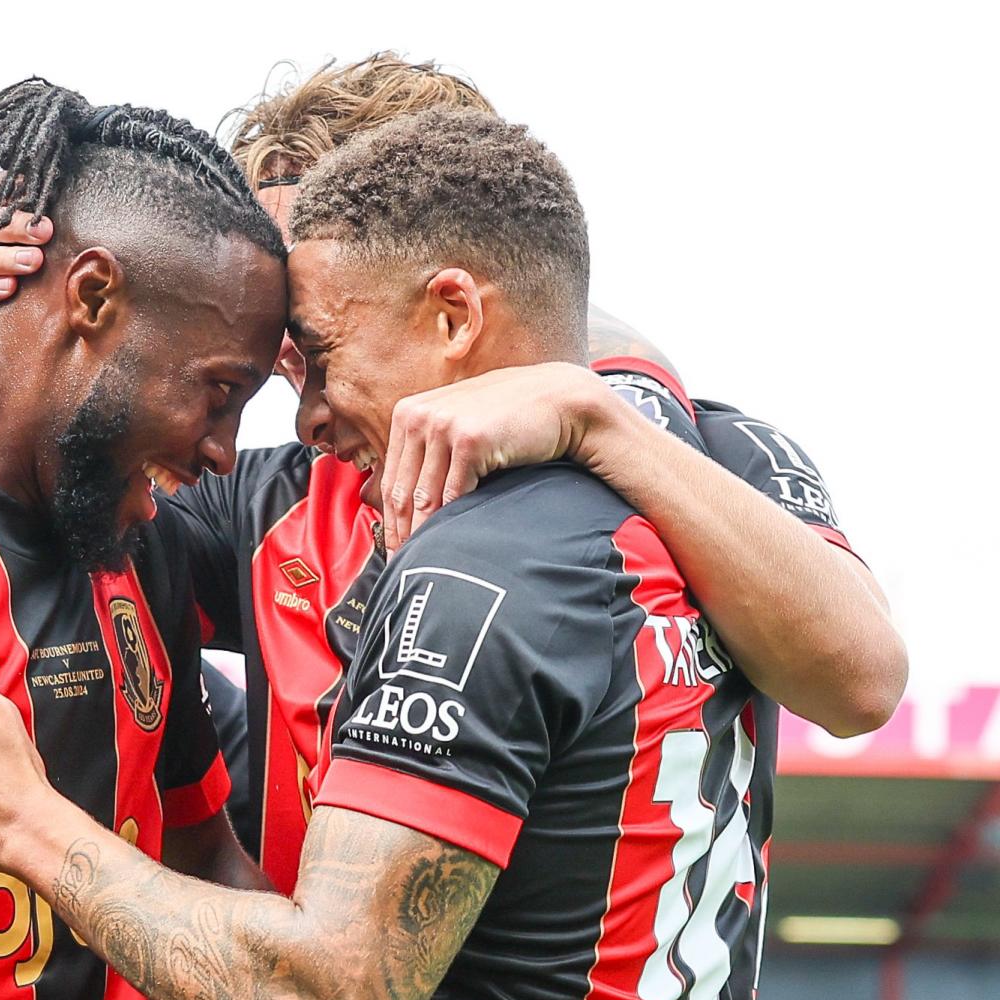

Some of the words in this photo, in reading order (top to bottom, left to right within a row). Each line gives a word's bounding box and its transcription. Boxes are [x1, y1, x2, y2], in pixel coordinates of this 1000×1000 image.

[274, 591, 310, 611] umbro
[40, 641, 99, 659] BOURNEMOUTH
[351, 684, 466, 742] LEOS
[347, 728, 453, 757] INTERNATIONAL
